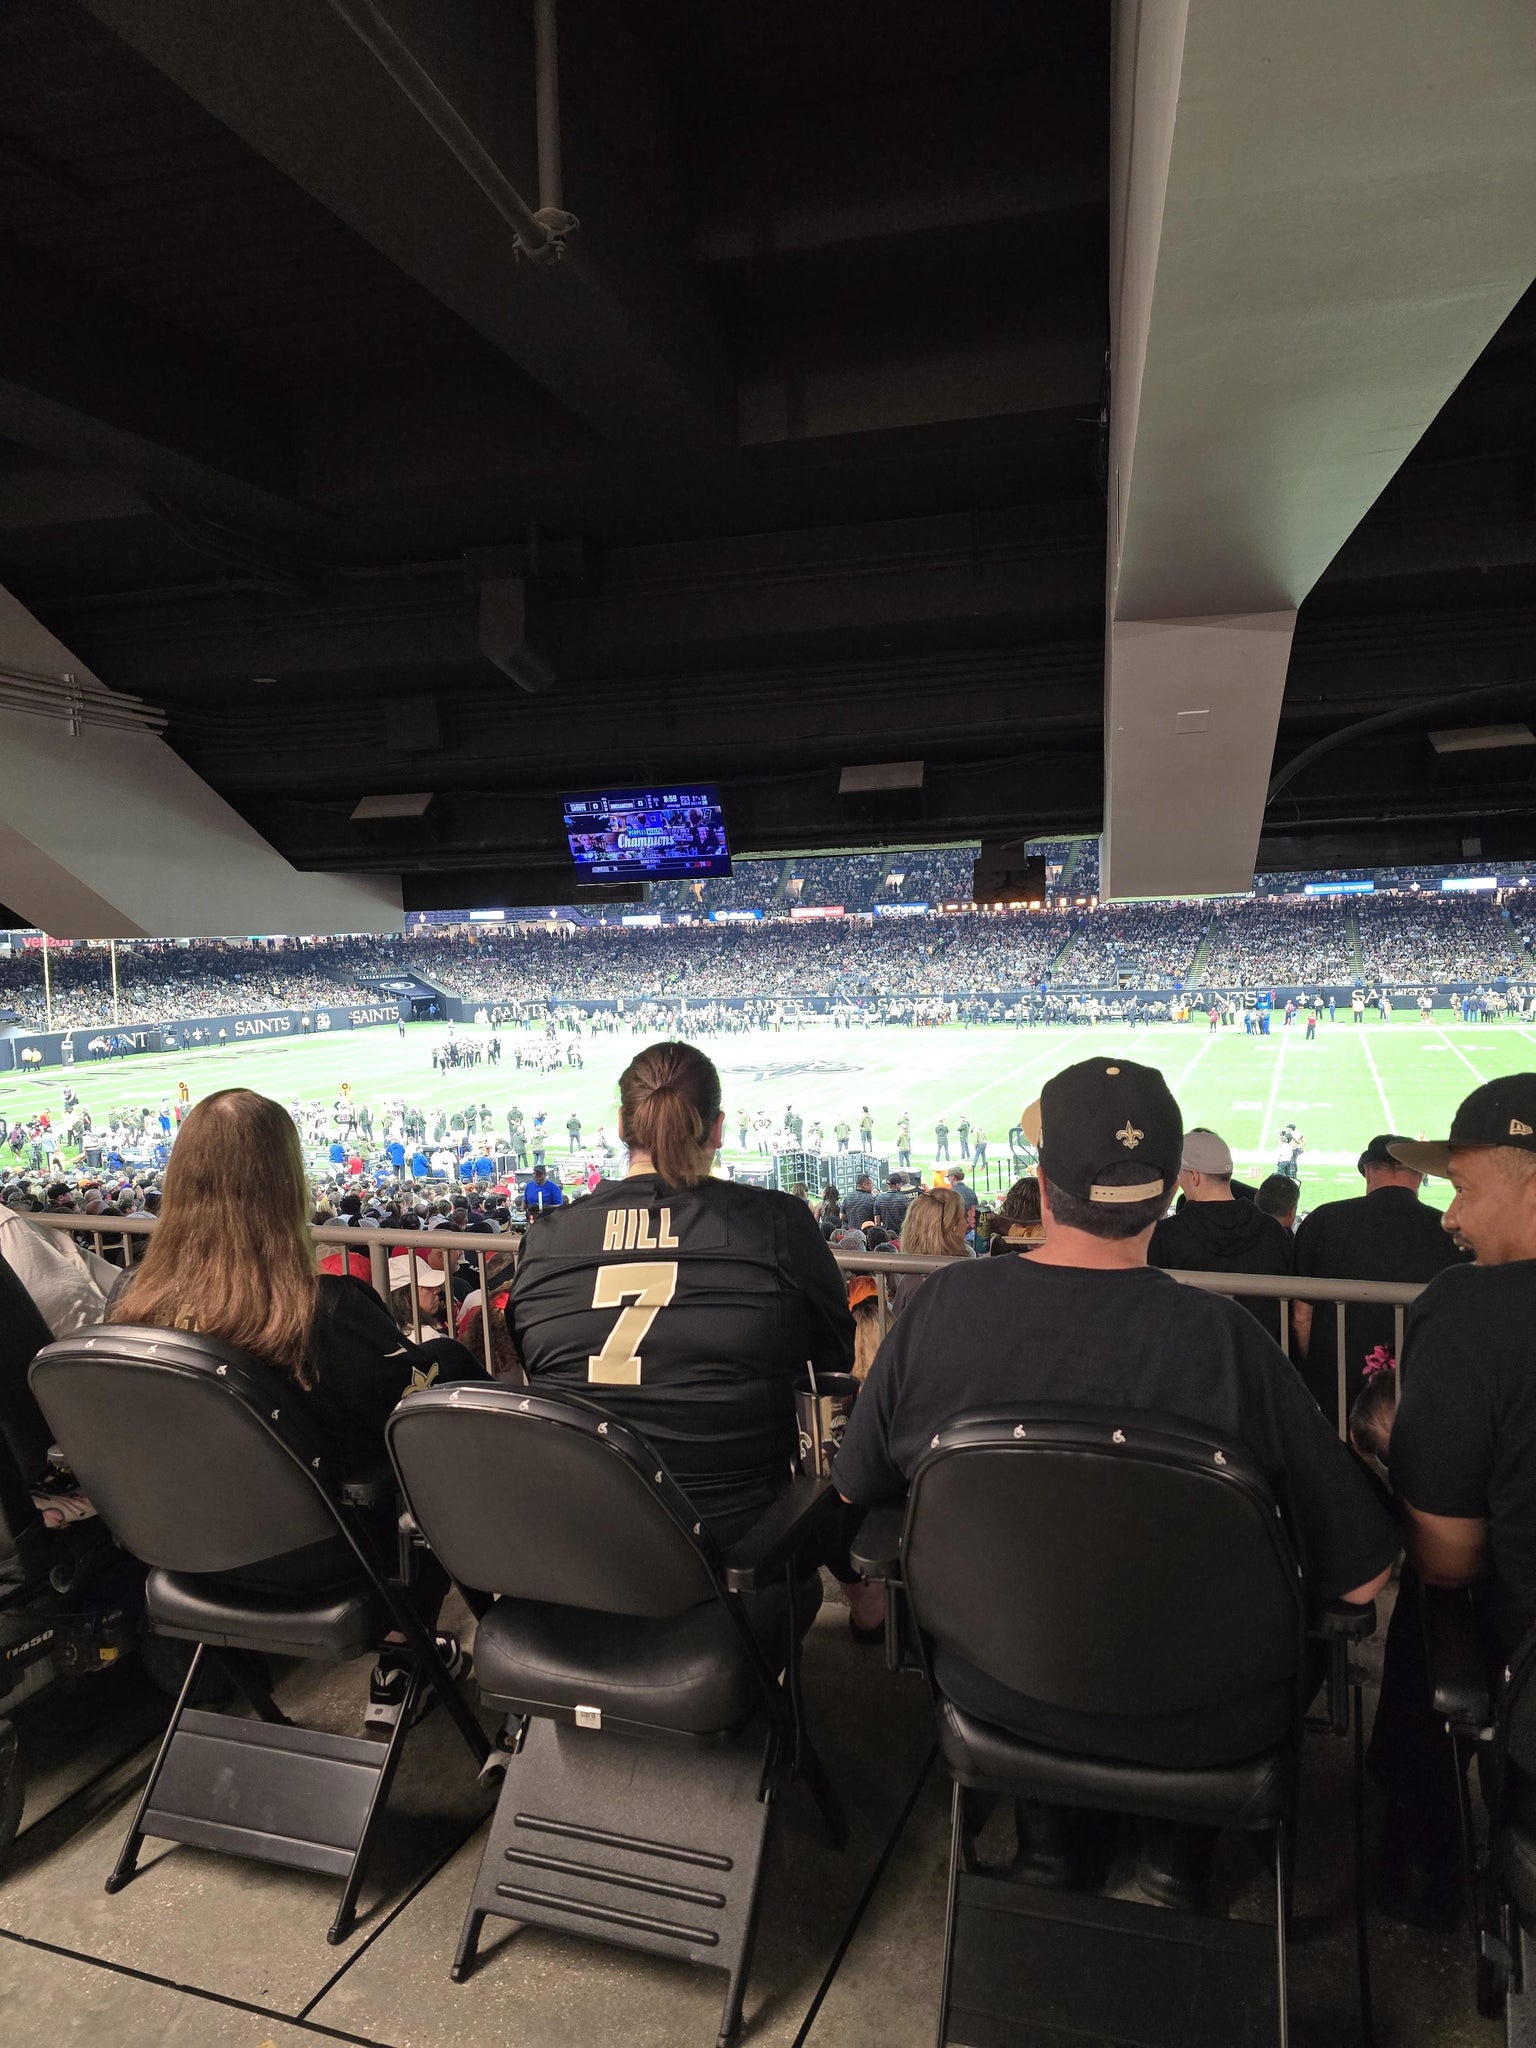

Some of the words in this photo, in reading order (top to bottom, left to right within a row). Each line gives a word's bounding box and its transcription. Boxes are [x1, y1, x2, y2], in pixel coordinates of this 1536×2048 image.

[617, 834, 677, 849] Champions
[764, 910, 790, 918] SAINTS
[882, 903, 928, 915] Ochsner
[22, 936, 74, 949] verzon
[353, 1006, 400, 1024] SAINTS
[235, 1016, 290, 1037] SAINTS
[602, 1207, 680, 1251] HILL
[588, 1261, 679, 1386] 7
